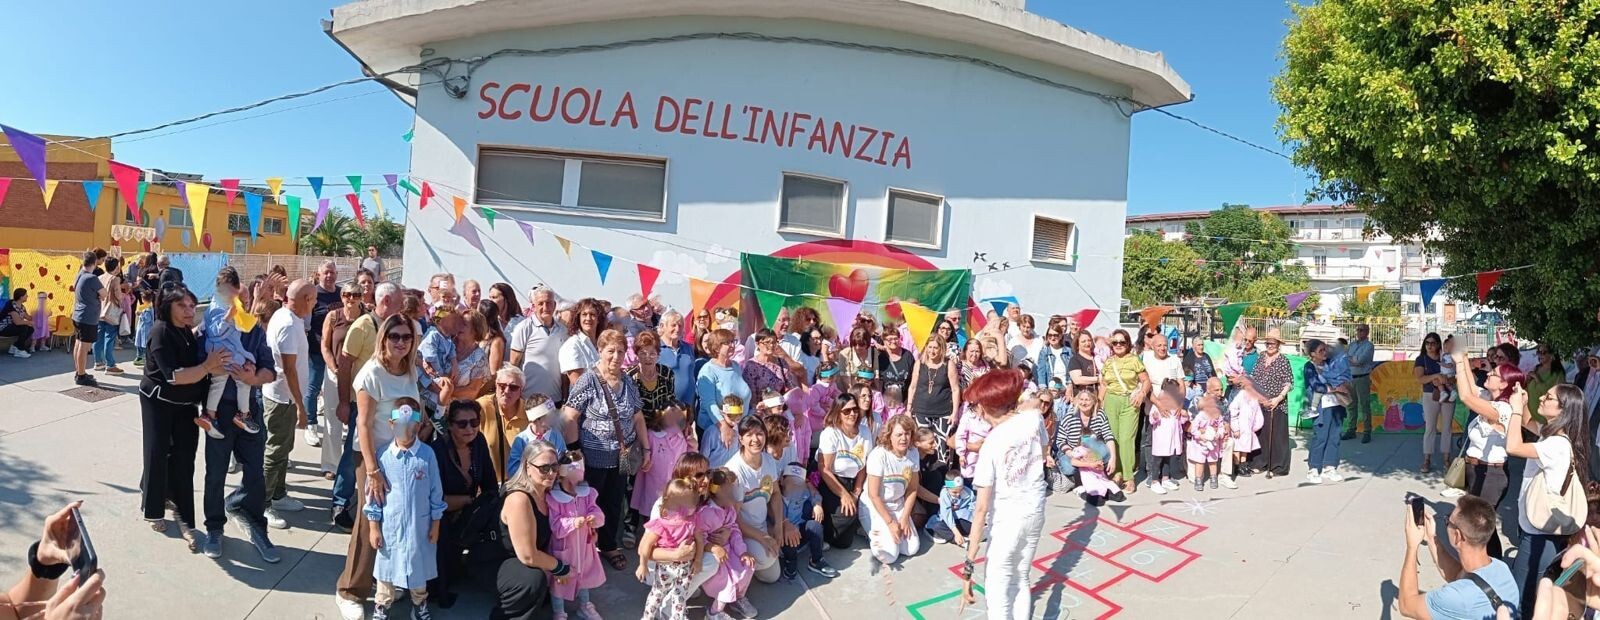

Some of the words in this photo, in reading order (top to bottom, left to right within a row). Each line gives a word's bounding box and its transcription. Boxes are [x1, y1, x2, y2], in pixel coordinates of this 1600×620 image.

[477, 81, 639, 129] SCUOLA
[654, 95, 912, 170] DELL'INFANZIA
[1131, 549, 1169, 565] 6
